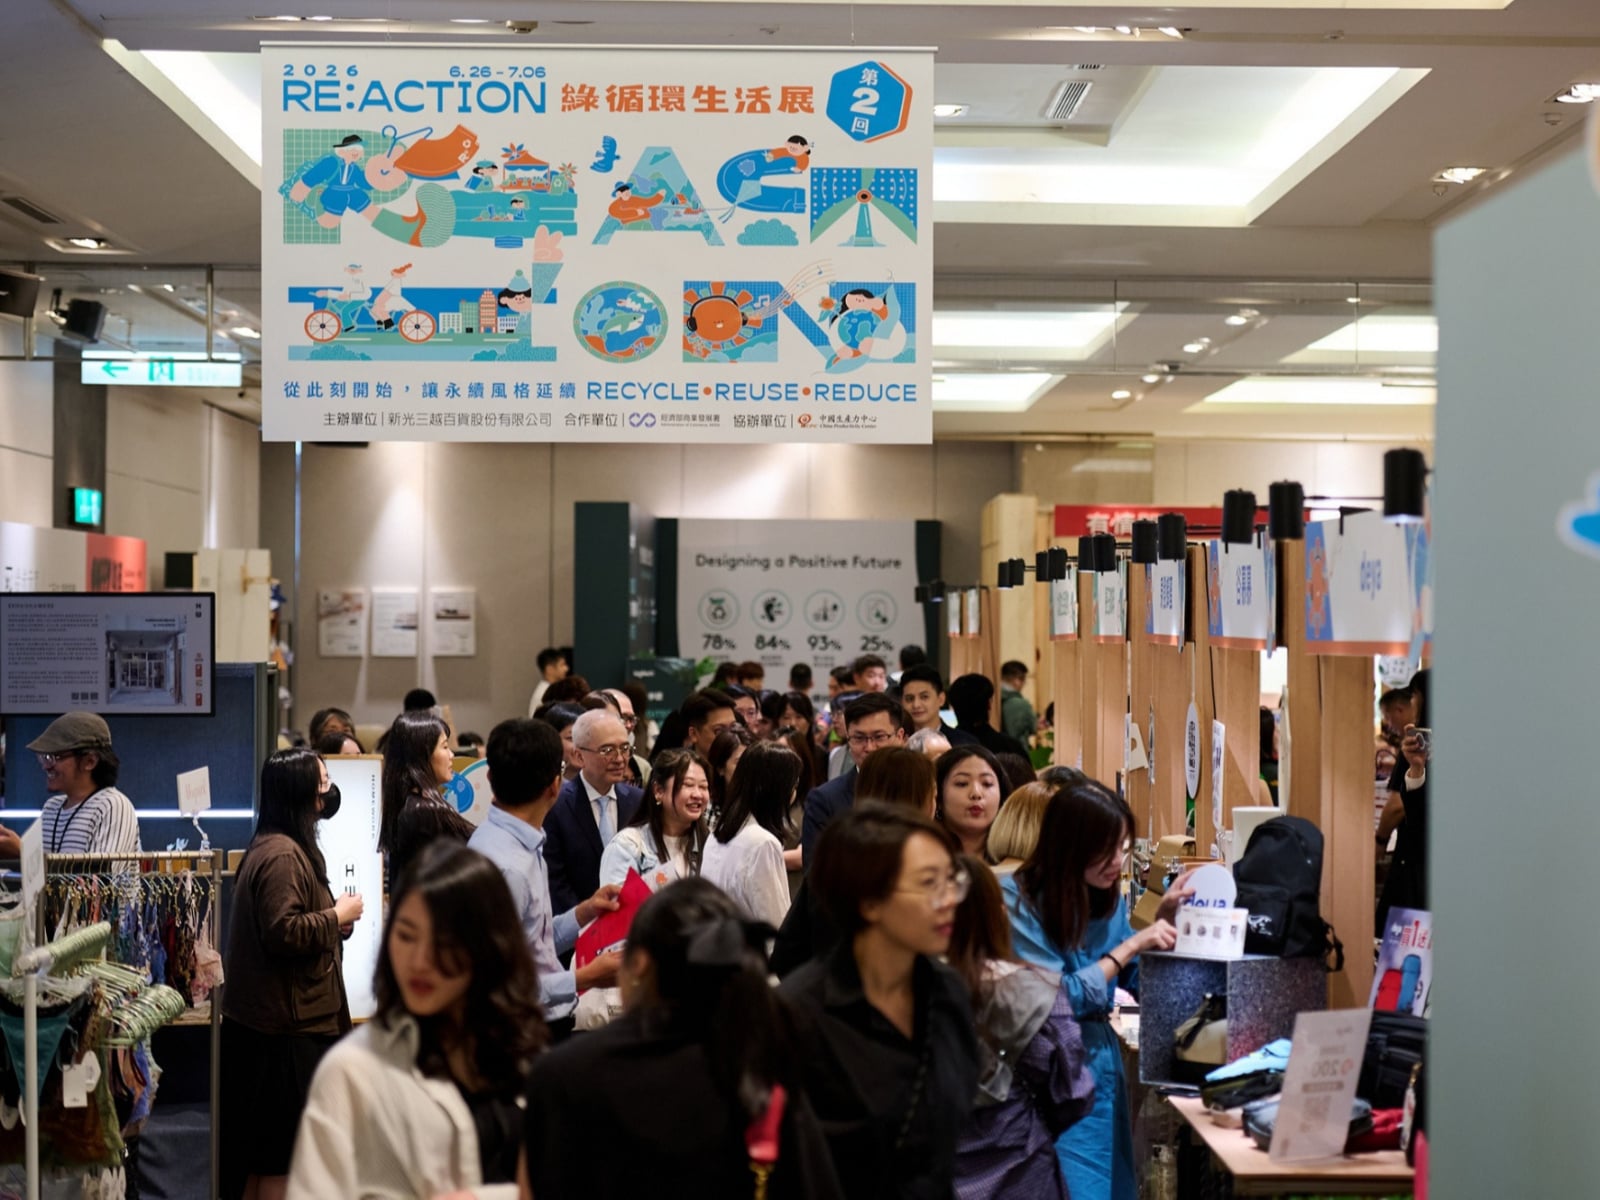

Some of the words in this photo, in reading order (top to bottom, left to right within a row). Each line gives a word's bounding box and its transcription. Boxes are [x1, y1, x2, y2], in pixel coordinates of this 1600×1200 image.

[283, 64, 358, 77] 2026
[282, 79, 546, 114] RE:ACTION
[560, 83, 816, 115] 綠循環生活展
[586, 381, 700, 401] RECYCLE
[715, 382, 799, 402] REUSE
[814, 383, 917, 402] REDUCE
[323, 412, 378, 427] 主辦單位
[388, 412, 552, 427] 新光三越百貨股份有限公司
[564, 412, 618, 428] 合作單位
[733, 413, 787, 429] 協辦單位
[695, 553, 771, 572] Designing
[774, 558, 785, 568] a
[788, 555, 848, 569] Positive
[851, 556, 902, 569] Future
[702, 634, 737, 651] 78%
[754, 634, 791, 651] 84%
[807, 634, 843, 652] 93%
[860, 635, 894, 652] 25%
